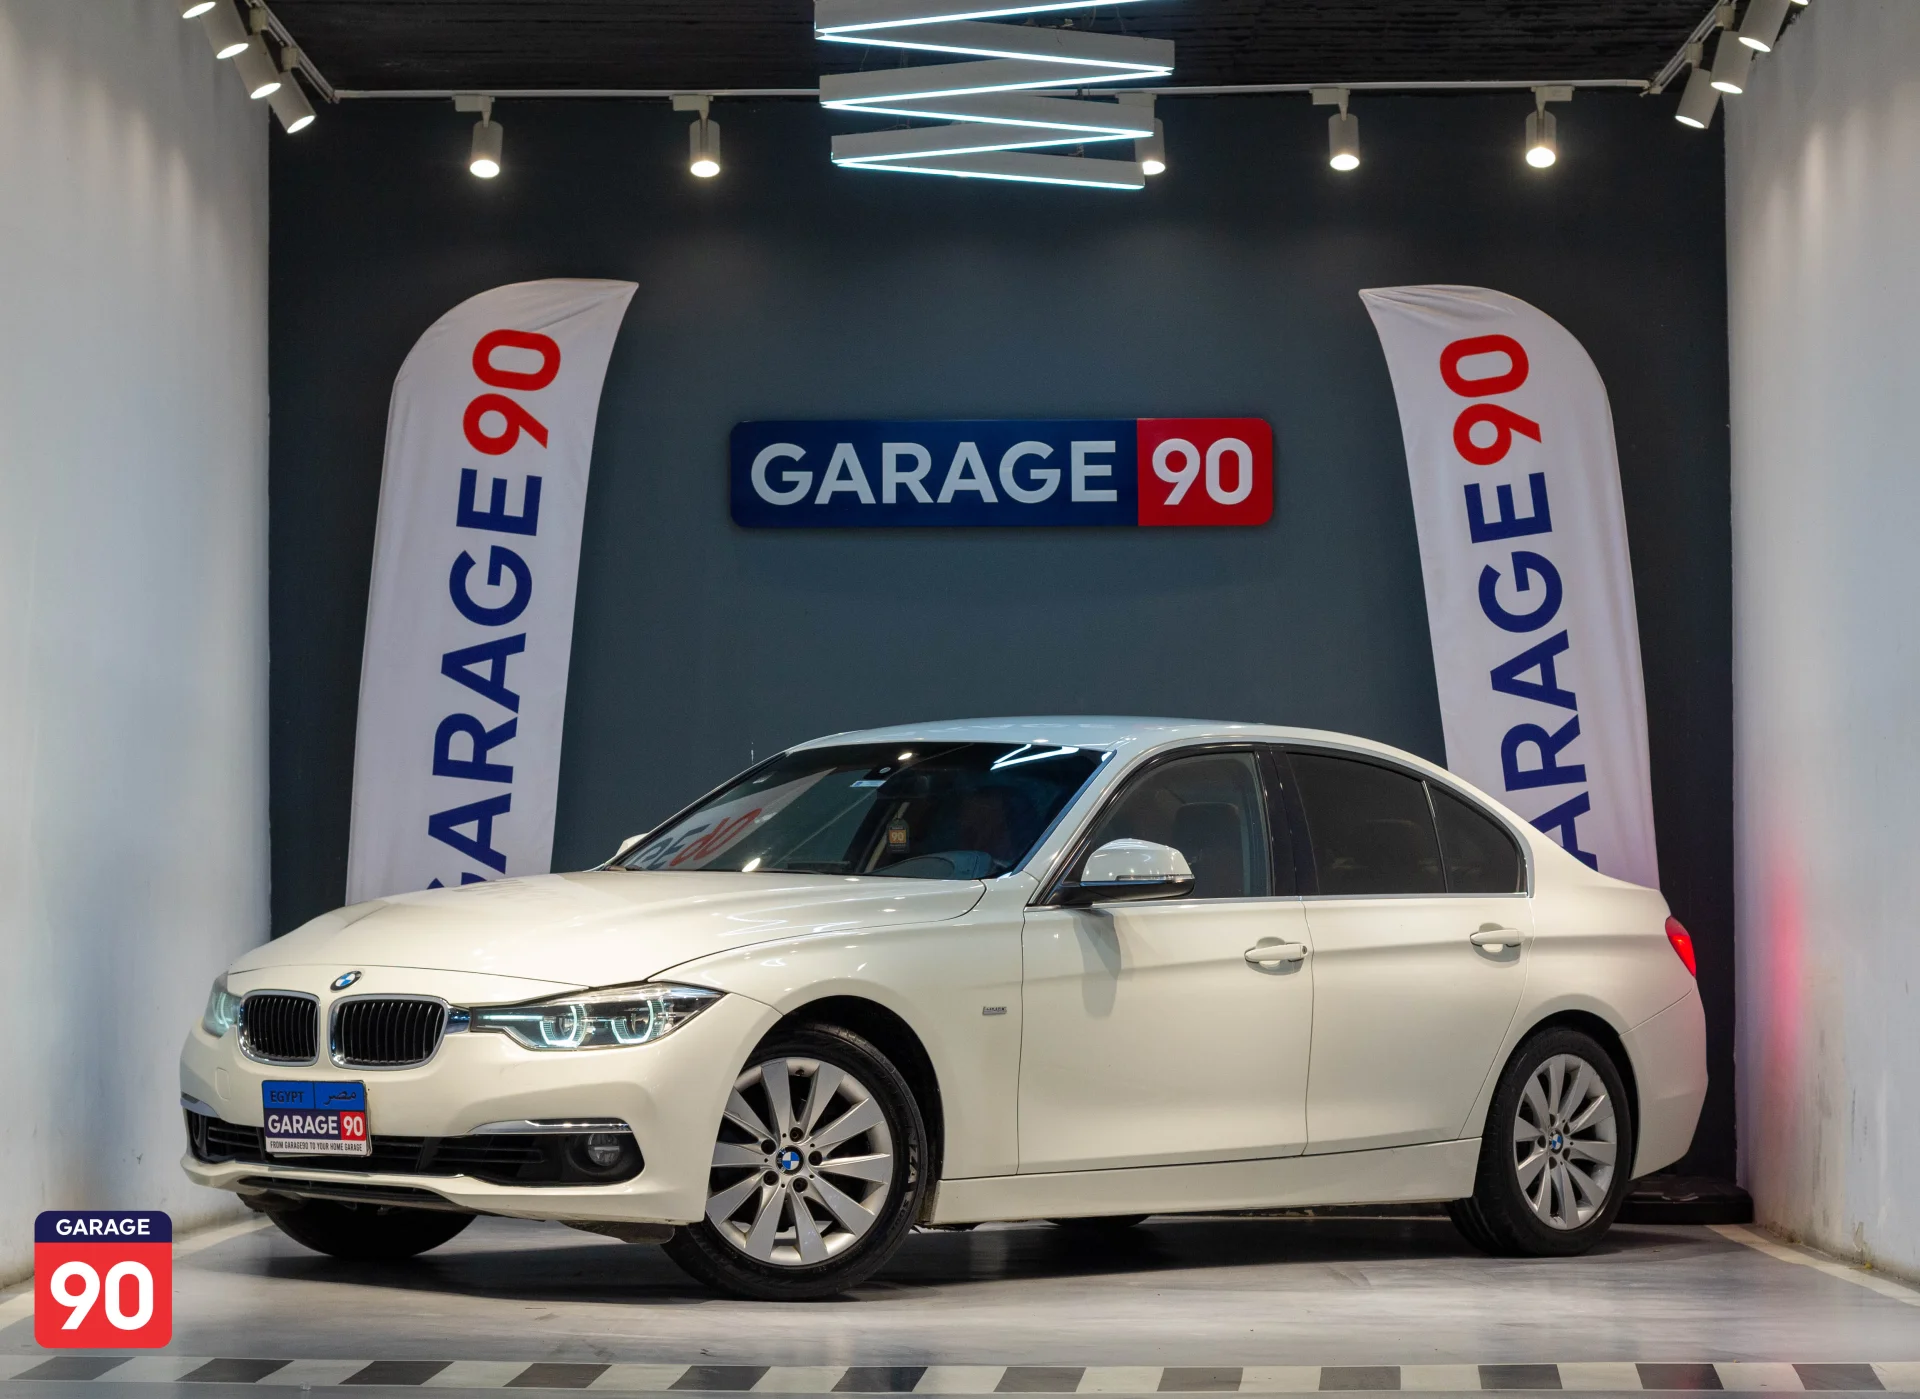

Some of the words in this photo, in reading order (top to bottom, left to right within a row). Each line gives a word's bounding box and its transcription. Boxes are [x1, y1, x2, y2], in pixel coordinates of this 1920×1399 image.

[750, 440, 1118, 506] GARAGE
[1151, 437, 1254, 506] 90
[270, 1090, 304, 1104] EGYPT
[323, 1090, 357, 1106] مصر
[267, 1114, 339, 1135] GARAGE
[343, 1115, 364, 1137] 90
[270, 1141, 284, 1150] FROM
[284, 1141, 309, 1151] GARAGE90
[309, 1142, 316, 1151] TO
[317, 1142, 330, 1151] YOUR
[330, 1143, 344, 1152] HOME
[344, 1143, 363, 1152] GARAGE
